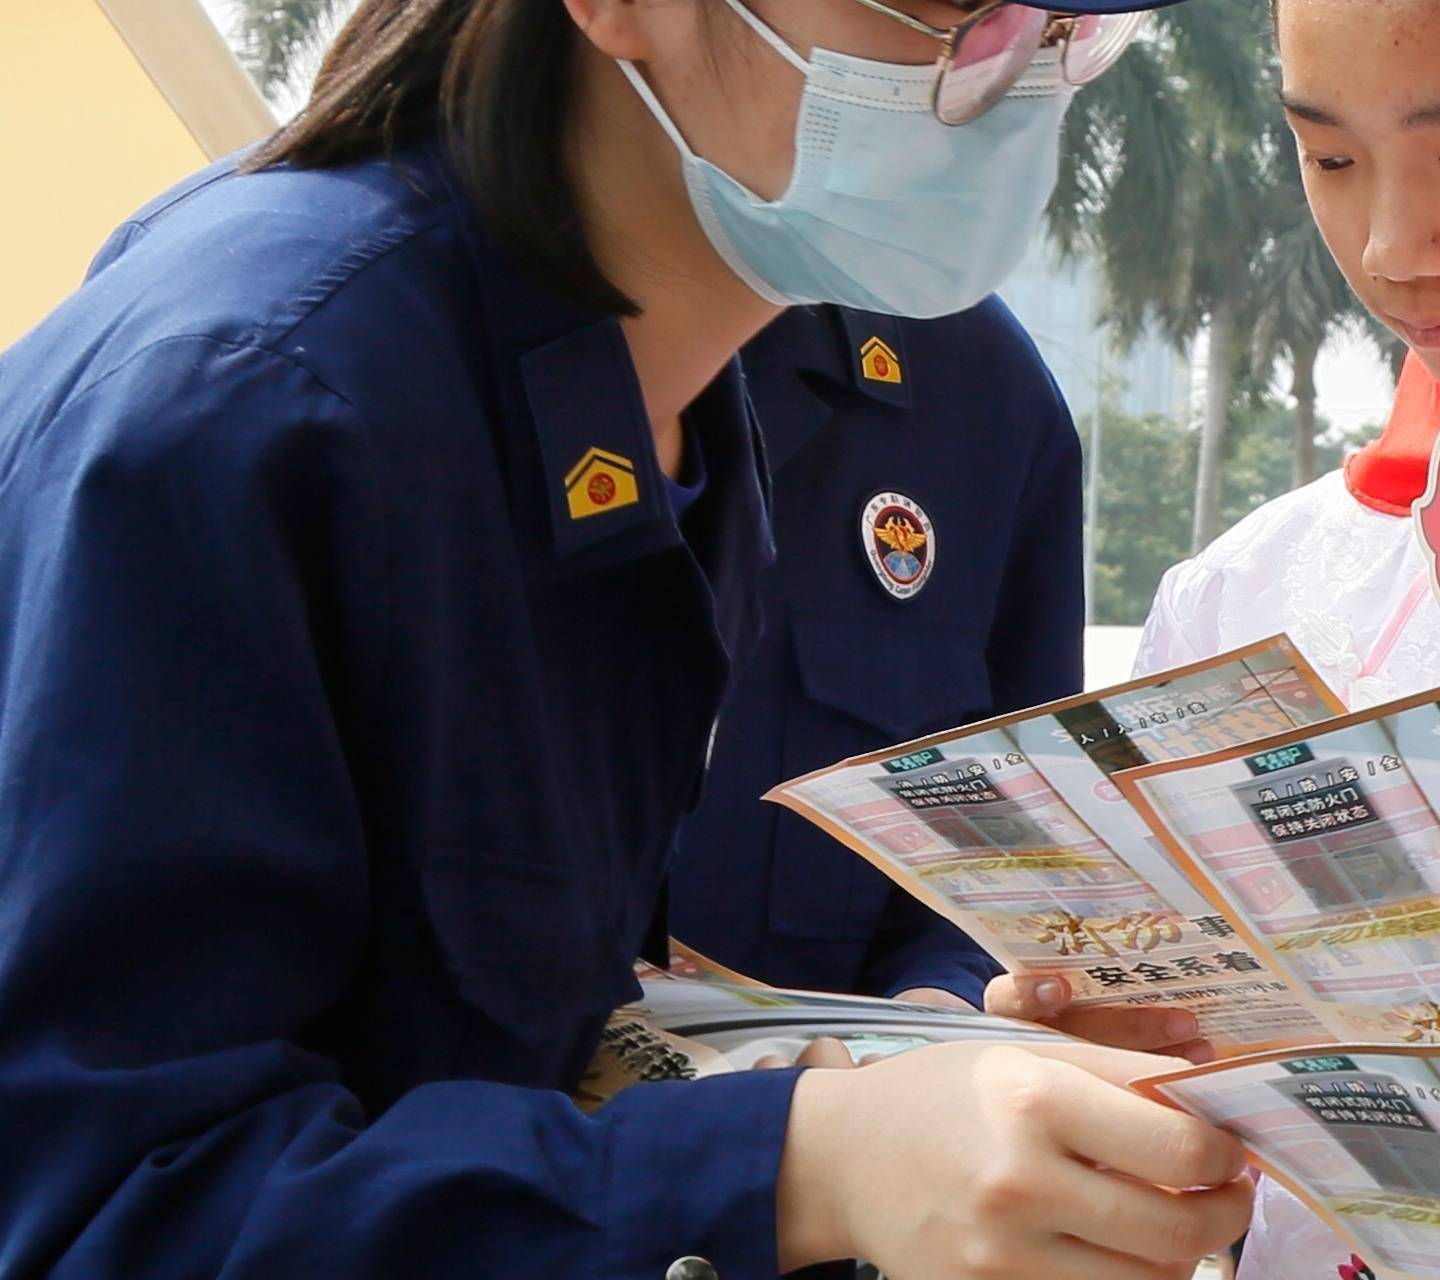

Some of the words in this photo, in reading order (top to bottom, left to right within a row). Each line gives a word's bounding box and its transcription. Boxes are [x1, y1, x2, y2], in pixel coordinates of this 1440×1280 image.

[1260, 786, 1360, 821] 常闭式防火门
[1271, 804, 1370, 838] 保持关闭状态
[1084, 950, 1264, 987] 安全系着
